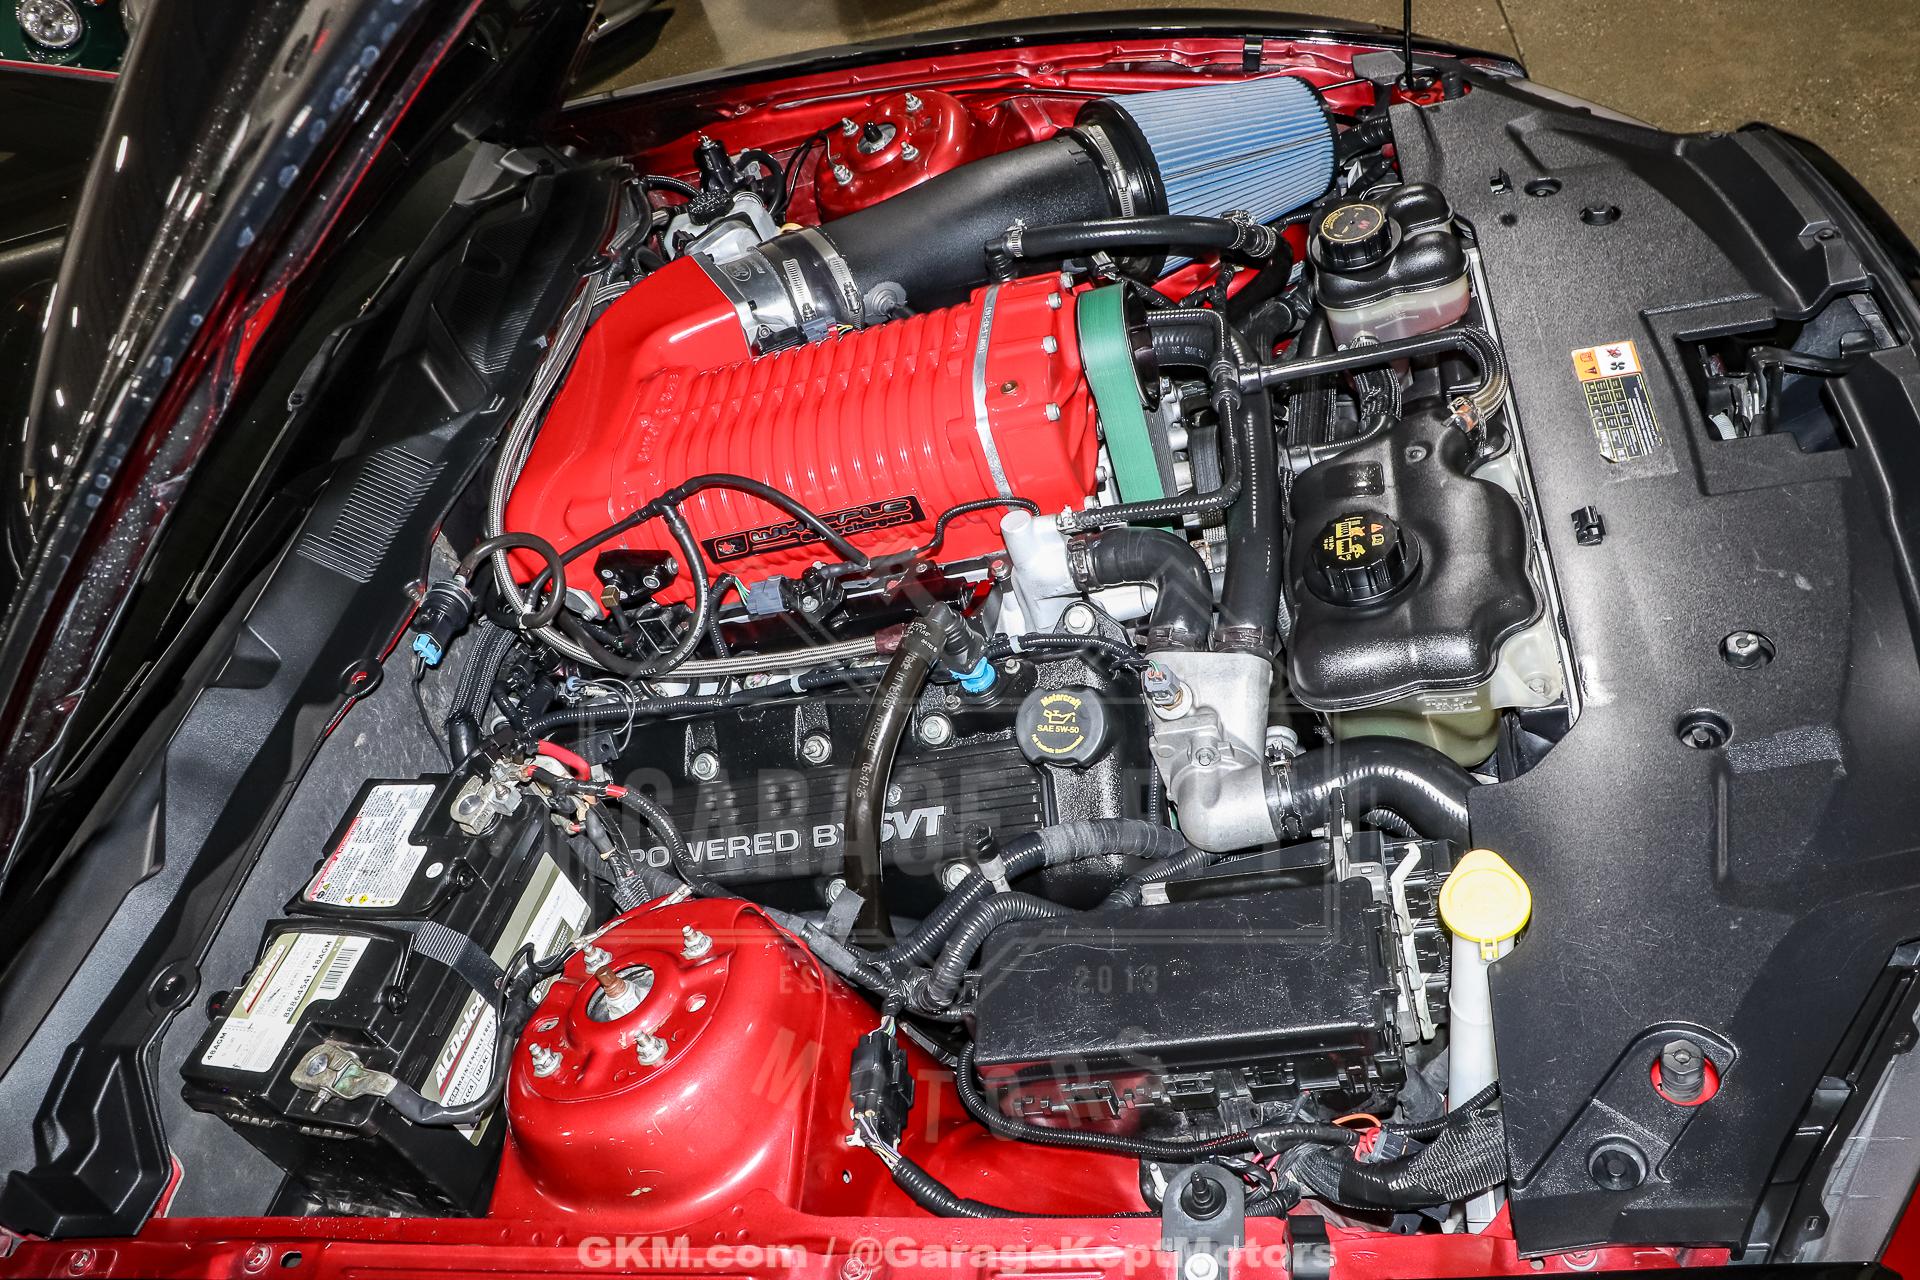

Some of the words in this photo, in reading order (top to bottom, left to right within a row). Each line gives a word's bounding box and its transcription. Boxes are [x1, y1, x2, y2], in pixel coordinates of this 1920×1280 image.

[1040, 693, 1082, 710] Motorcraft
[1036, 724, 1054, 733] SAE
[1055, 725, 1080, 734] 5W-50
[283, 974, 312, 1018] 88864541
[311, 940, 333, 971] 48AGM
[206, 1032, 228, 1061] 48AGM
